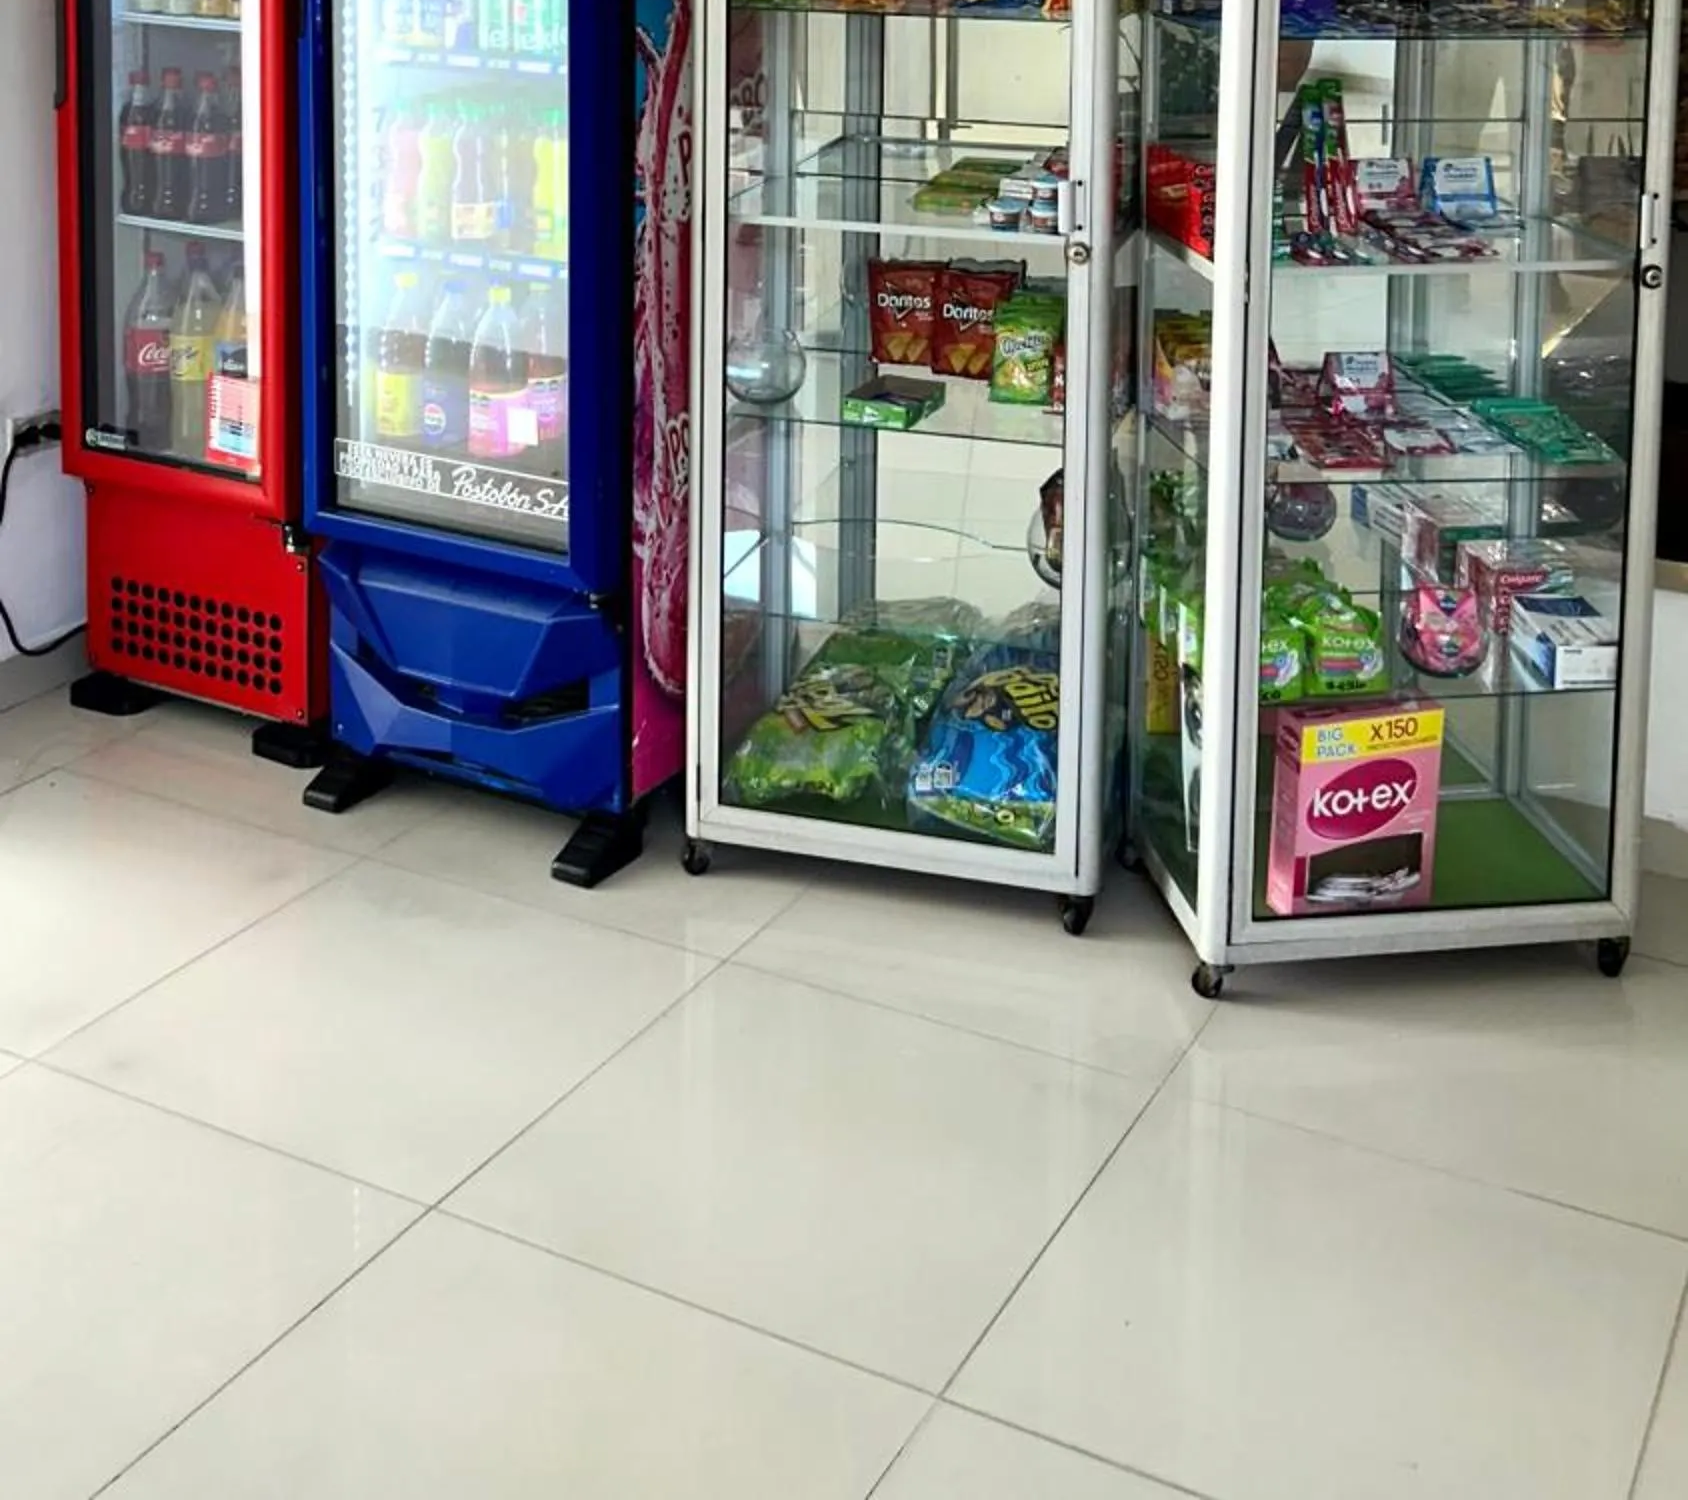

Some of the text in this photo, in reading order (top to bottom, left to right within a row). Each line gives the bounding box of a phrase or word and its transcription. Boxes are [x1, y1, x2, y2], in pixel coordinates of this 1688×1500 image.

[877, 292, 932, 310] Doritos
[1317, 728, 1344, 742] BIG
[1317, 742, 1357, 757] PACK
[1313, 779, 1413, 818] kotex
